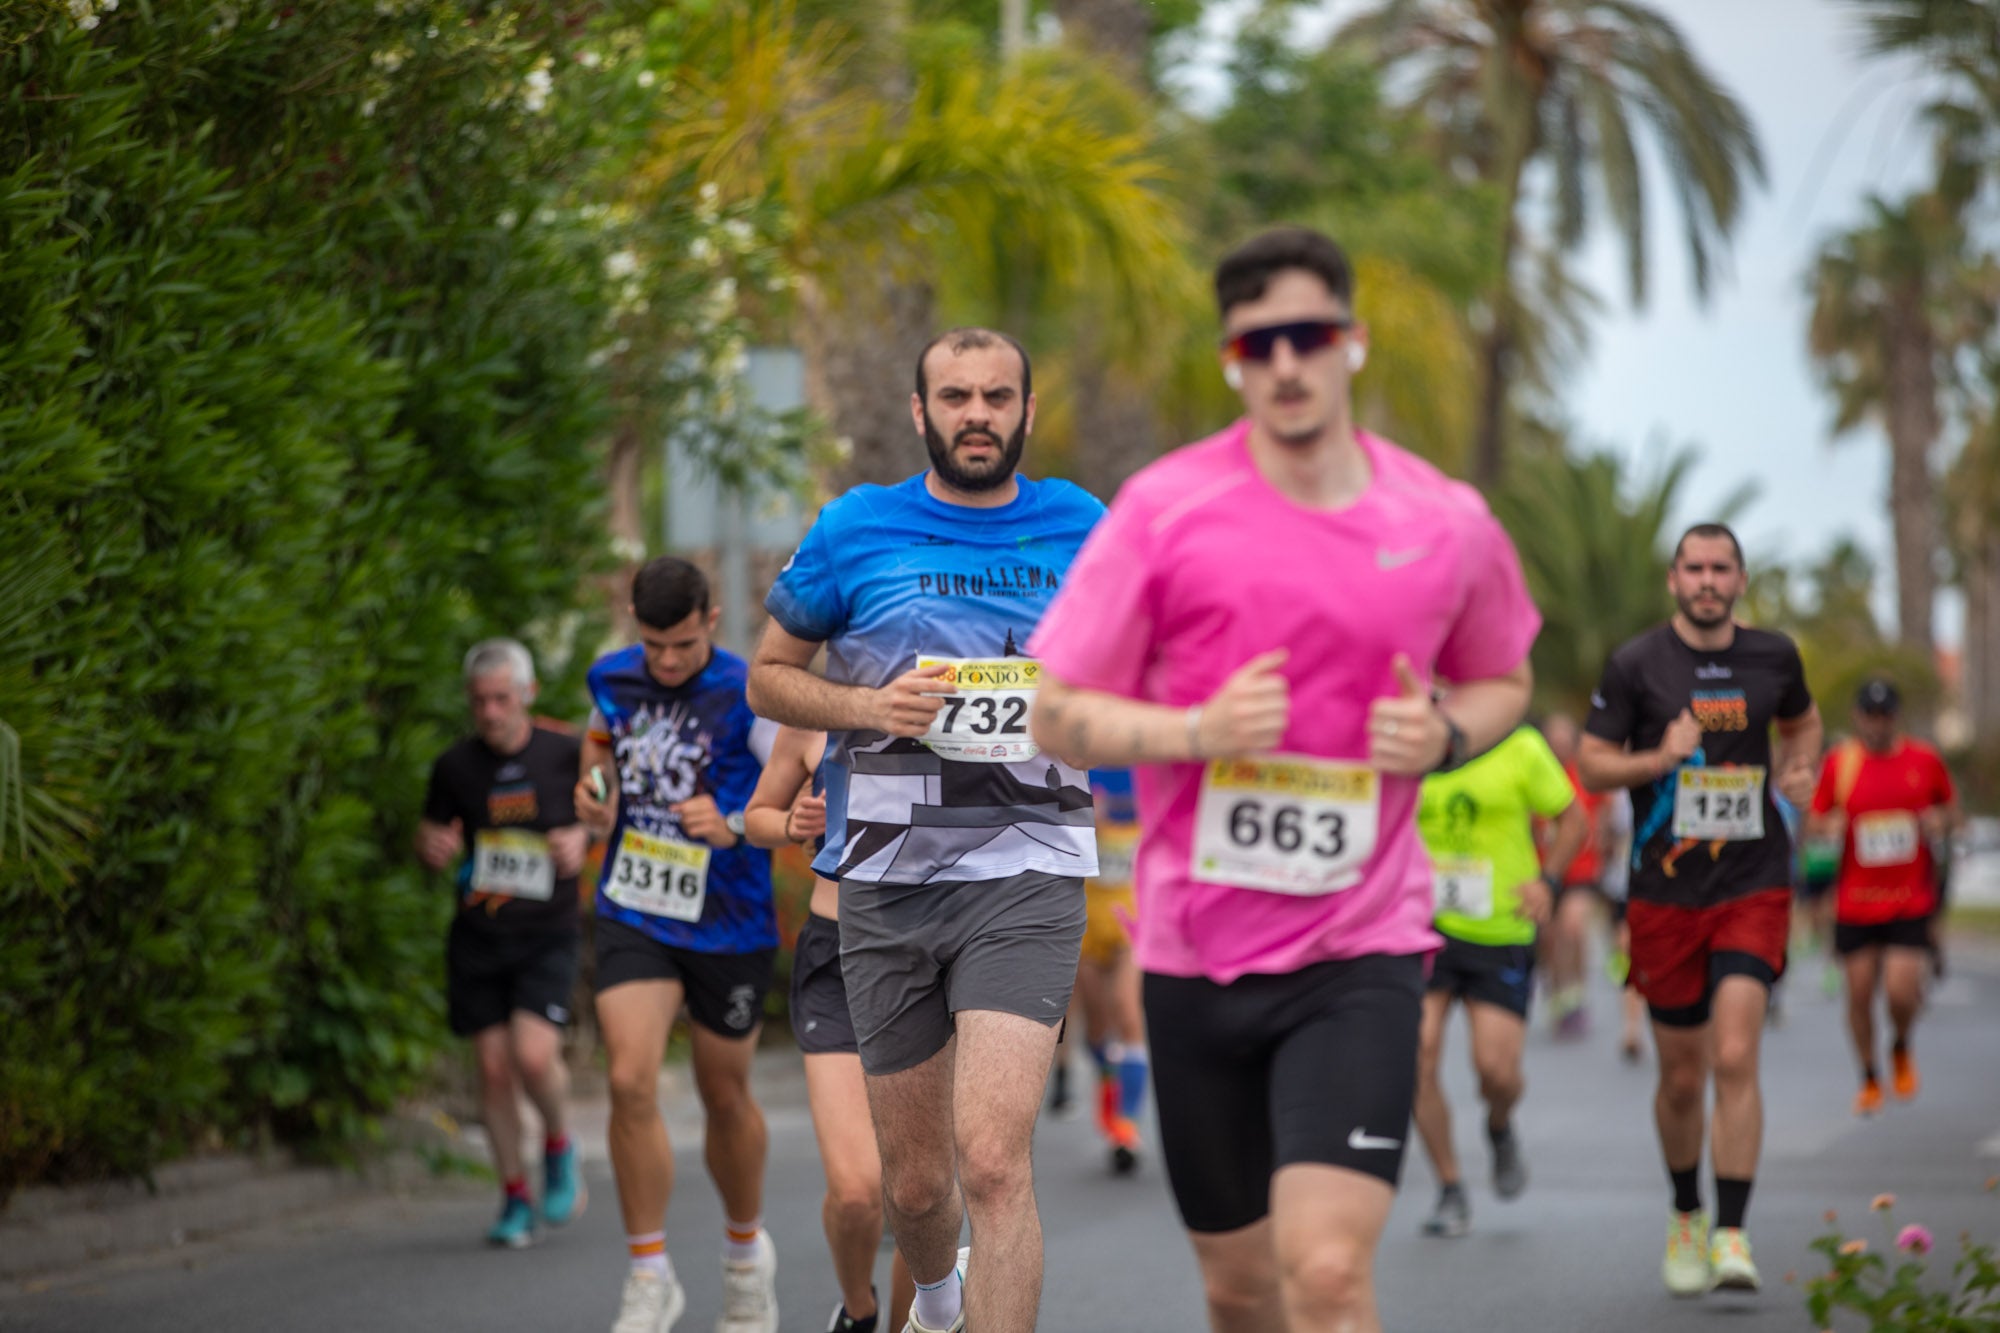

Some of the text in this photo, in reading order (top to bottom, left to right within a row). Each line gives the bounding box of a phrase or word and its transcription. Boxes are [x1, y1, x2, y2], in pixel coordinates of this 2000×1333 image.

[919, 566, 1060, 597] PURULLENA
[957, 671, 1019, 684] FONDO
[941, 696, 1028, 735] 732
[1693, 794, 1751, 821] 128
[1227, 799, 1346, 860] 663
[617, 855, 699, 899] 3316
